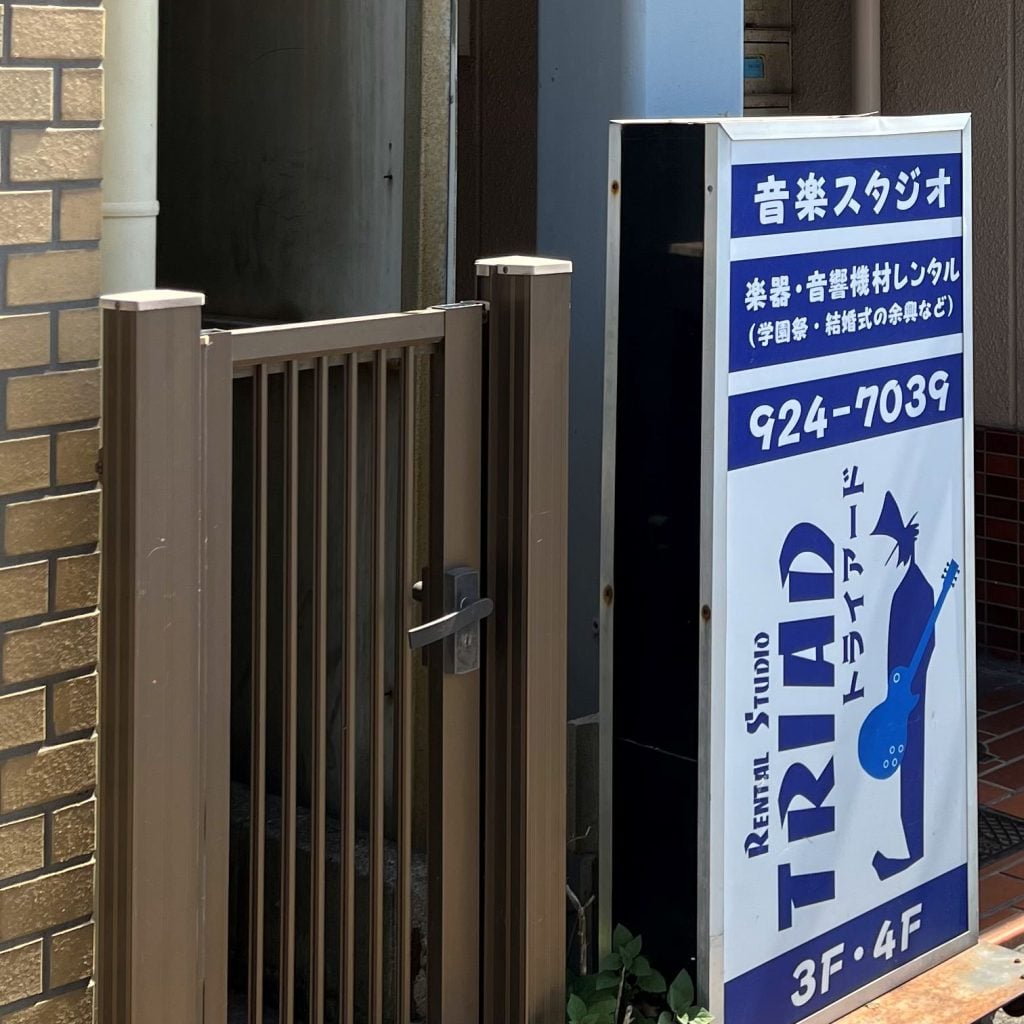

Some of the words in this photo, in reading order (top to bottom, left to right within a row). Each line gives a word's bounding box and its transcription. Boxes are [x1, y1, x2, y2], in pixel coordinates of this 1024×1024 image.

[754, 166, 951, 226] 音楽スタジオ
[744, 257, 961, 312] 楽器・音響機材レンタル
[750, 370, 950, 451] 924-7039
[842, 464, 866, 704] トライアード
[745, 631, 770, 736] STUDIO
[777, 521, 836, 932] TRIAD
[744, 751, 770, 860] RENTAL
